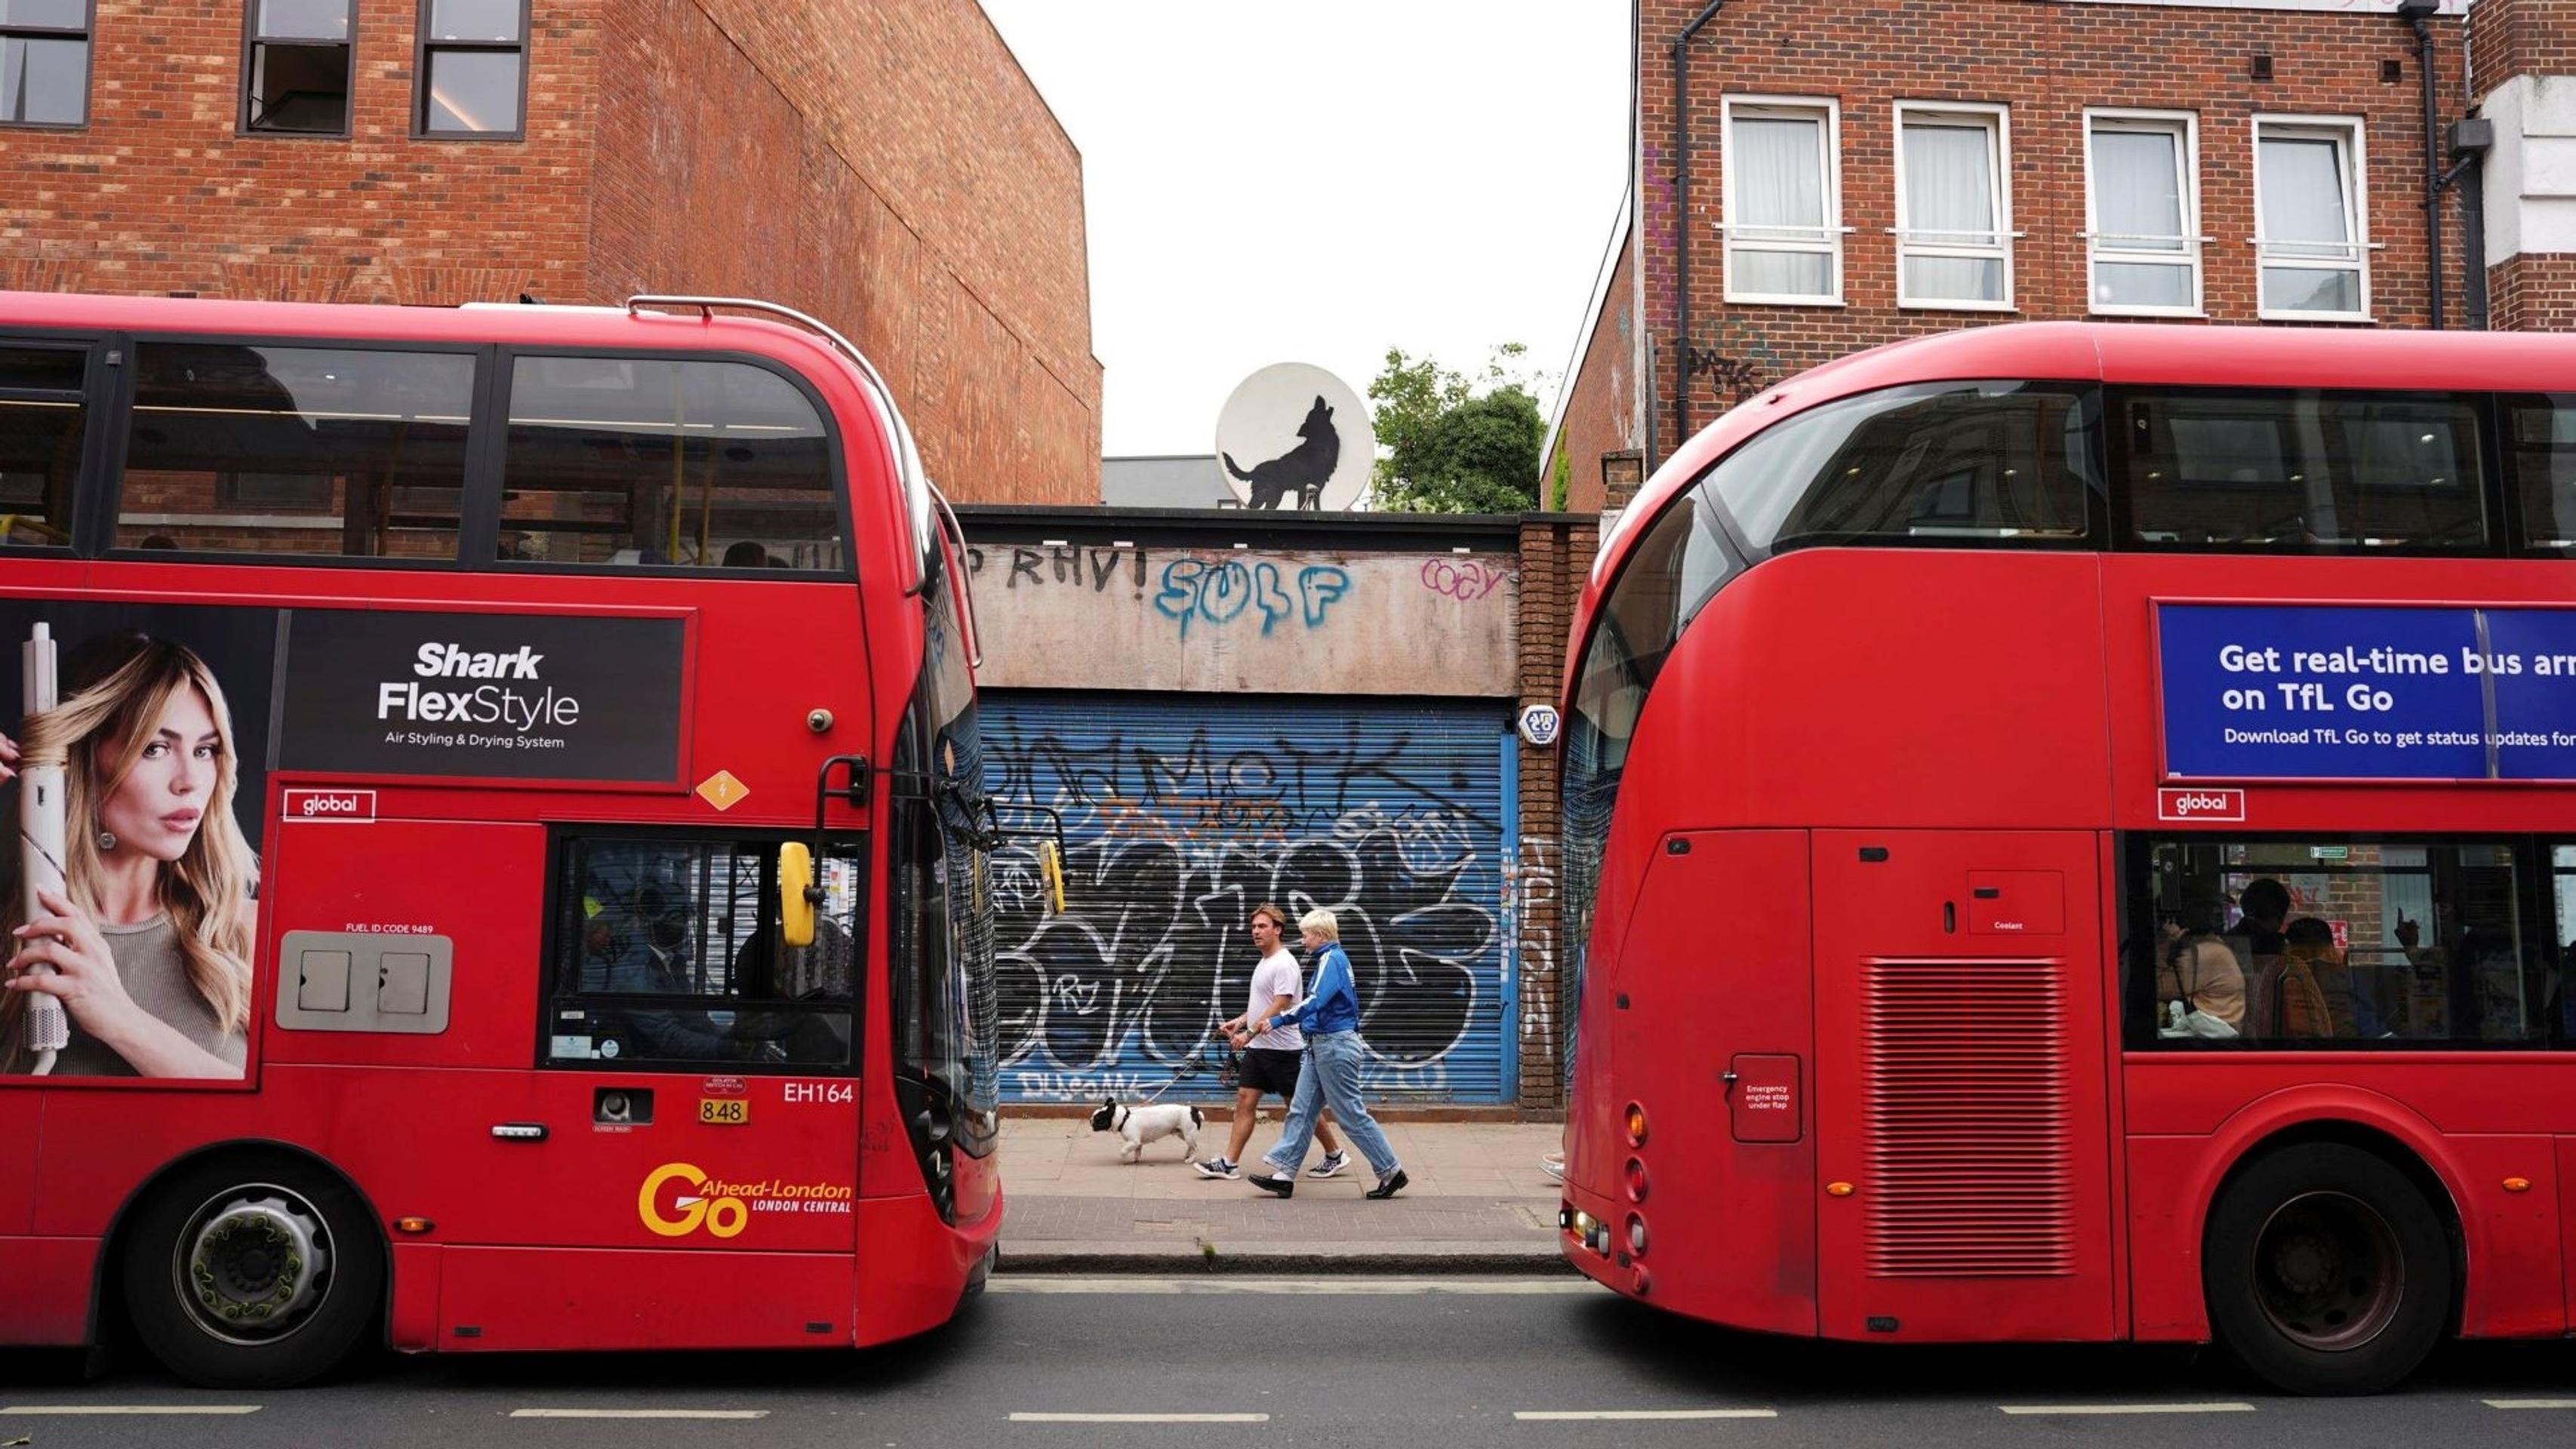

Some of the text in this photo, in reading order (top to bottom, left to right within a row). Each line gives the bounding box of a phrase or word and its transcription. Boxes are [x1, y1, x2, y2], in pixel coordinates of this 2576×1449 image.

[414, 641, 545, 679] Shark
[2220, 645, 2281, 672] Get
[2294, 645, 2449, 674] real-time
[2462, 647, 2522, 674] bus
[378, 681, 579, 731] FlexStyle
[2222, 683, 2393, 712] on TfL Go
[385, 731, 565, 748] Air Styling & Drying System
[2224, 728, 2310, 744] Download
[2313, 729, 2340, 744] TfL
[2345, 730, 2368, 744] Go
[2374, 731, 2391, 745] to
[2396, 731, 2423, 748] get
[2427, 731, 2479, 745] status
[2485, 731, 2548, 749] updates
[303, 795, 357, 815] global
[2176, 793, 2227, 815] global
[346, 923, 369, 932] FUEL
[371, 924, 381, 933] ID
[383, 924, 410, 934] CODE
[1994, 921, 2023, 930] Coolant
[784, 1083, 853, 1103] EH164
[1746, 1094, 1790, 1102] engine stop
[1747, 1085, 1788, 1094] Emergency
[703, 1101, 741, 1121] 848
[1772, 1101, 1787, 1110] flap
[639, 1161, 851, 1238] Go Ahead-London
[752, 1199, 851, 1213] LONDON CENTRAL
